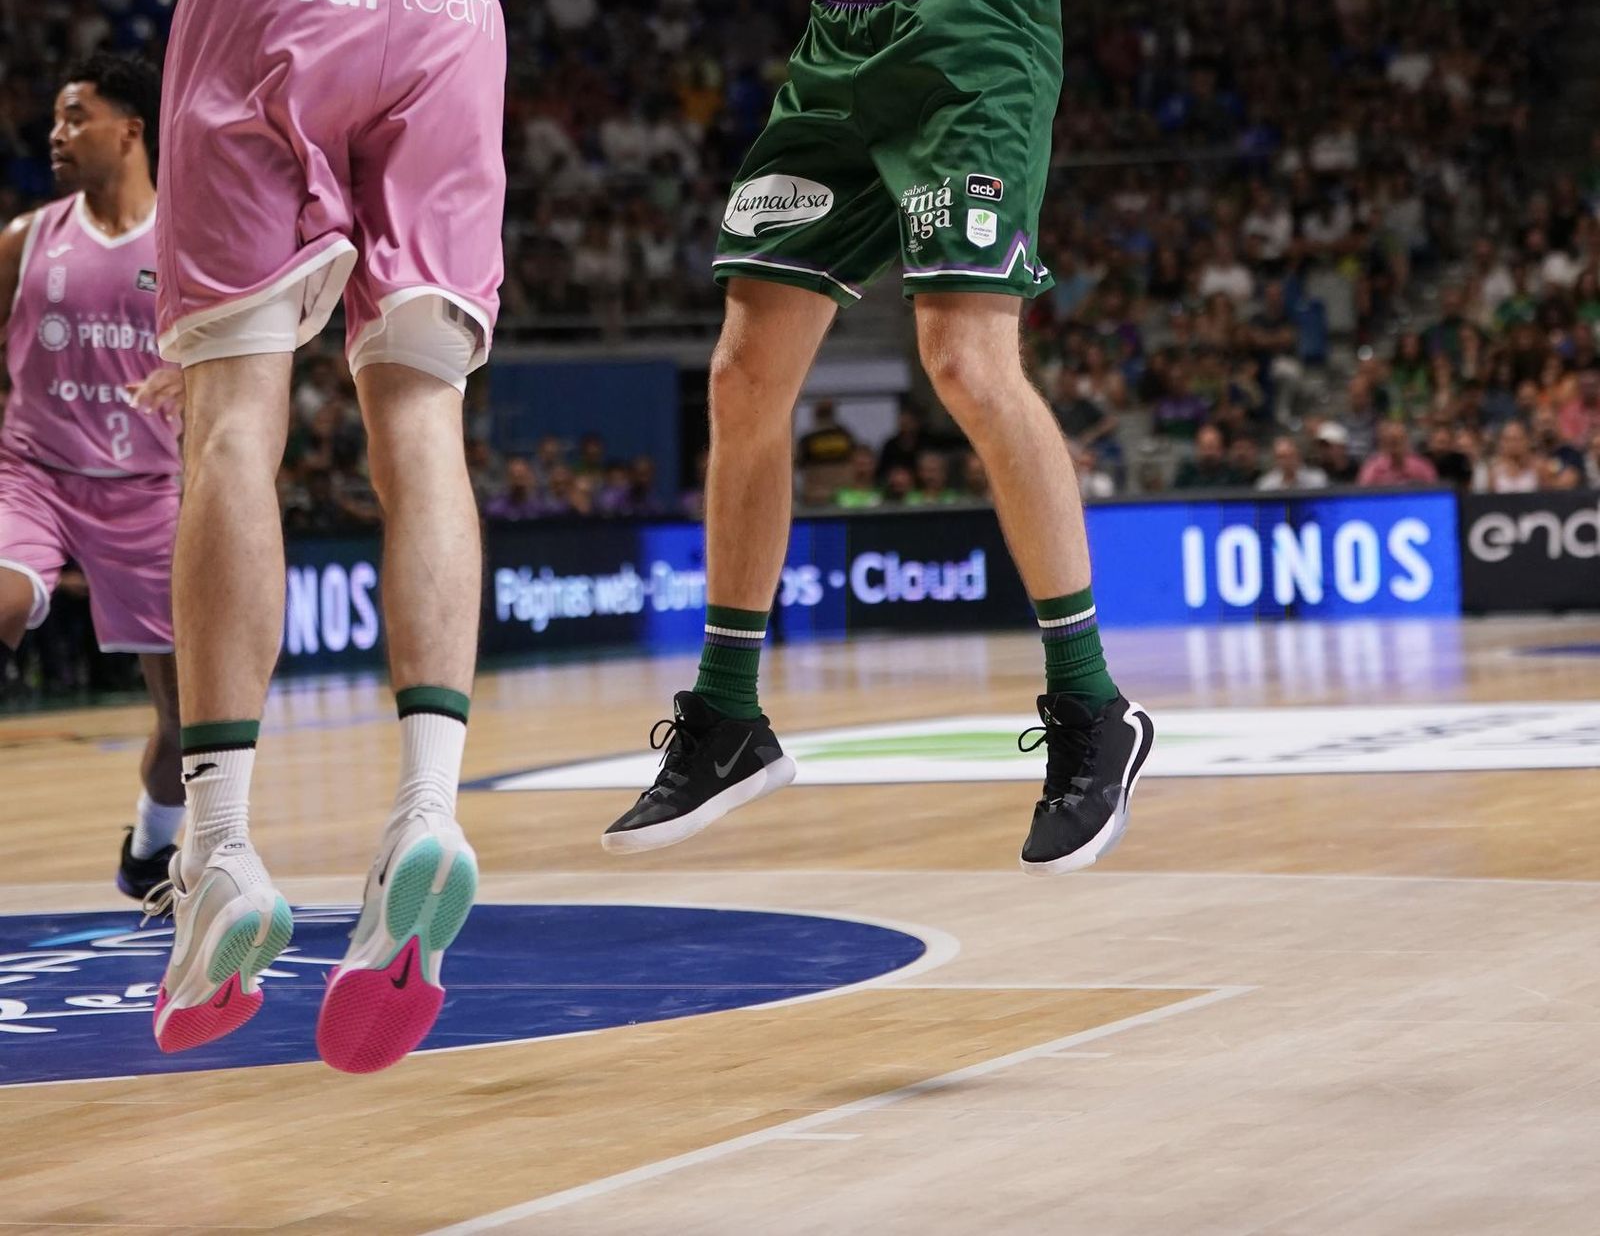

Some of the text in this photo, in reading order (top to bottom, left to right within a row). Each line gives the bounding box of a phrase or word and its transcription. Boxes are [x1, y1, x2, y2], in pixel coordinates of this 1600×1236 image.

[725, 181, 829, 222] famadesa
[970, 184, 995, 197] acb
[48, 380, 132, 404] JOVEN
[106, 410, 133, 462] 2
[1468, 498, 1600, 563] end
[849, 548, 988, 605] Cloud
[1181, 517, 1434, 609] IONOS
[286, 560, 379, 656] NOS
